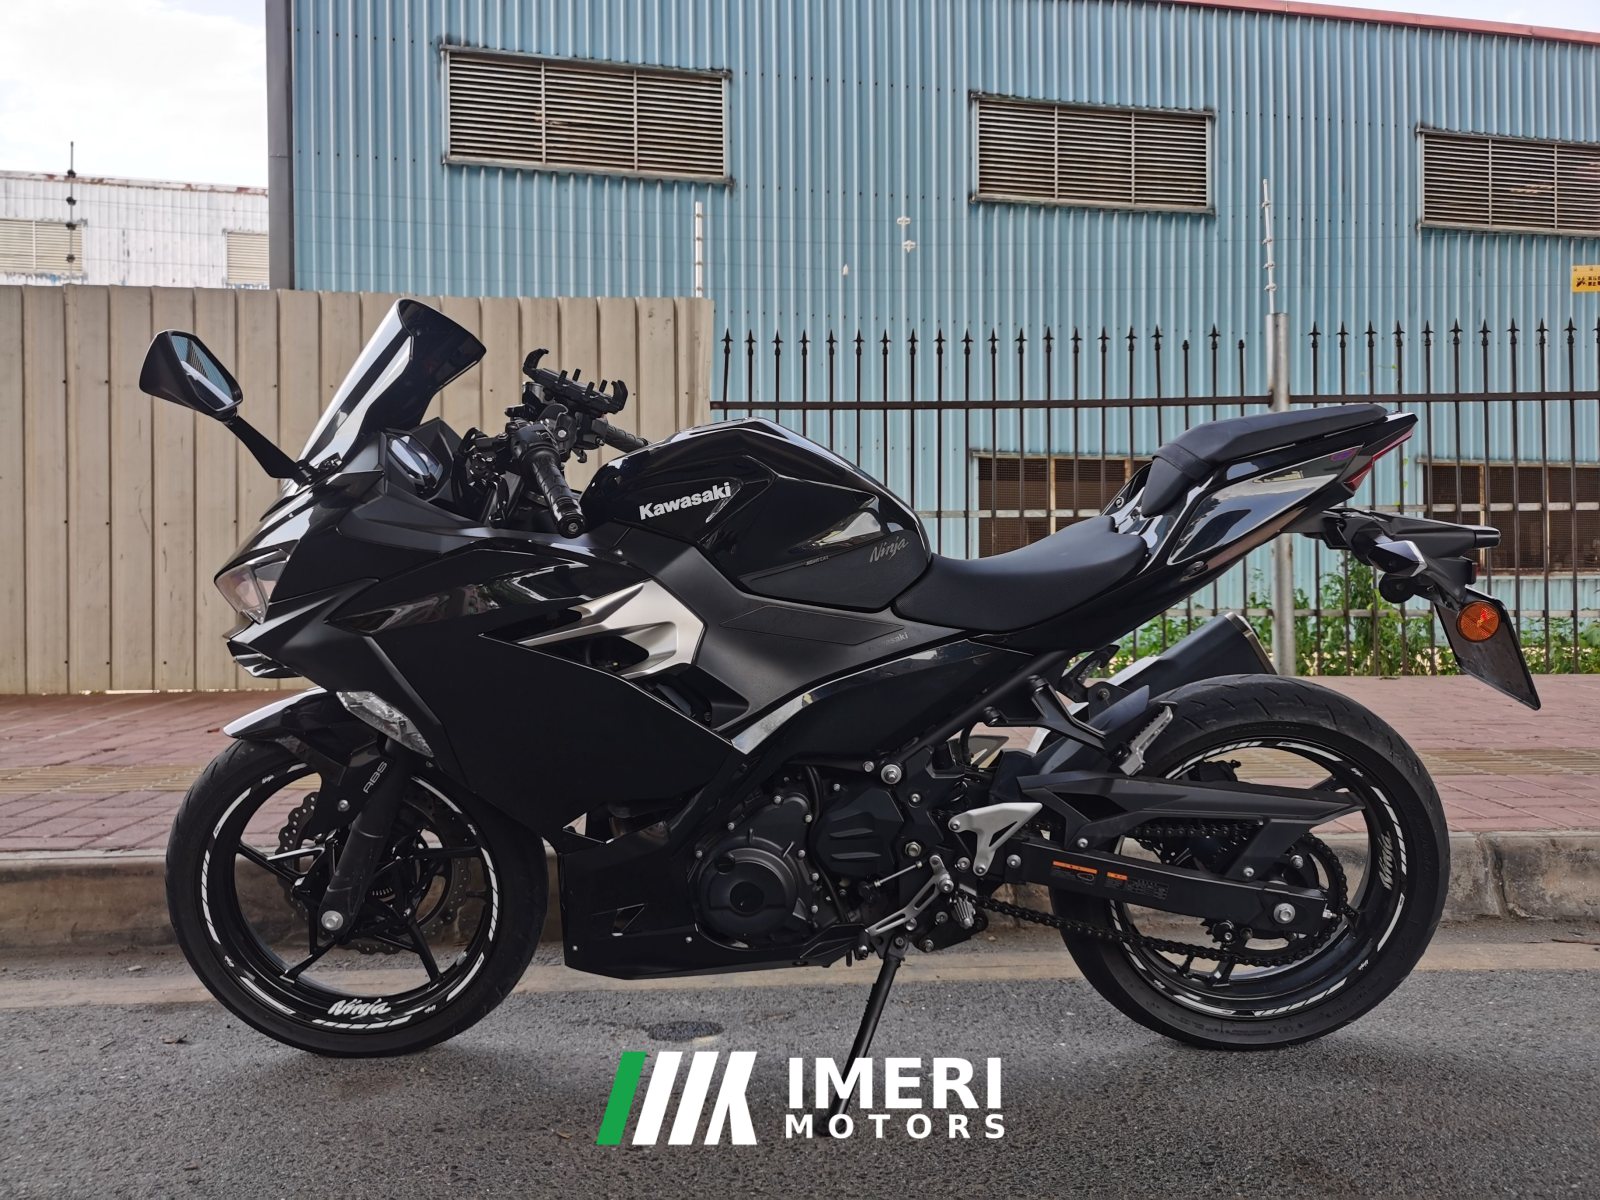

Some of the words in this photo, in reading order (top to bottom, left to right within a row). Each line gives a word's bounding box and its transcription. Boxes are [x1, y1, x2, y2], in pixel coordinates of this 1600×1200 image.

[639, 482, 732, 520] Kawasaki
[869, 536, 910, 563] Ninja
[362, 762, 388, 794] ABS
[1377, 830, 1397, 891] Ninja
[327, 997, 391, 1020] Ninja
